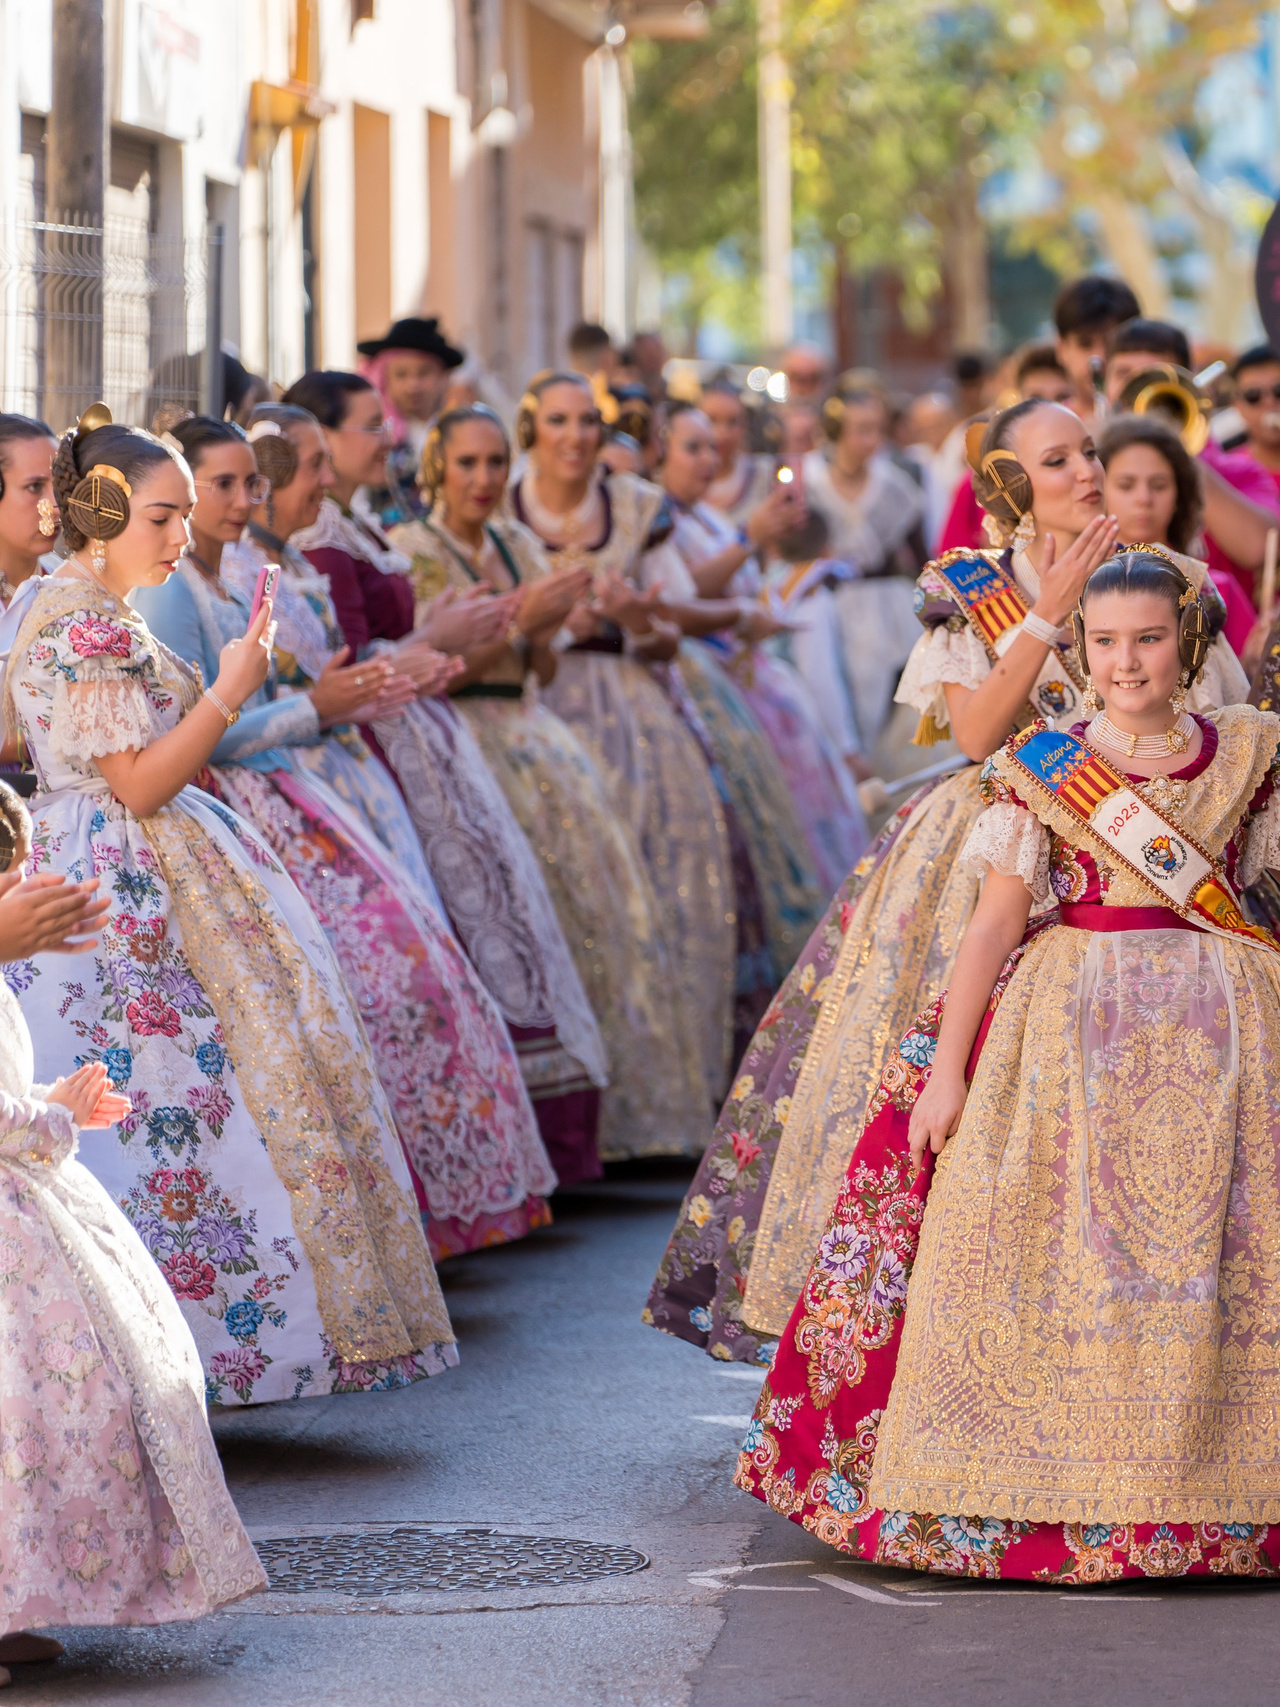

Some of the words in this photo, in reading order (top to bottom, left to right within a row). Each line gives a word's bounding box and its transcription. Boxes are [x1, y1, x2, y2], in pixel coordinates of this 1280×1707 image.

[1039, 740, 1076, 773] Aitana
[1107, 801, 1140, 837] 2025
[1140, 837, 1155, 852] FALLA
